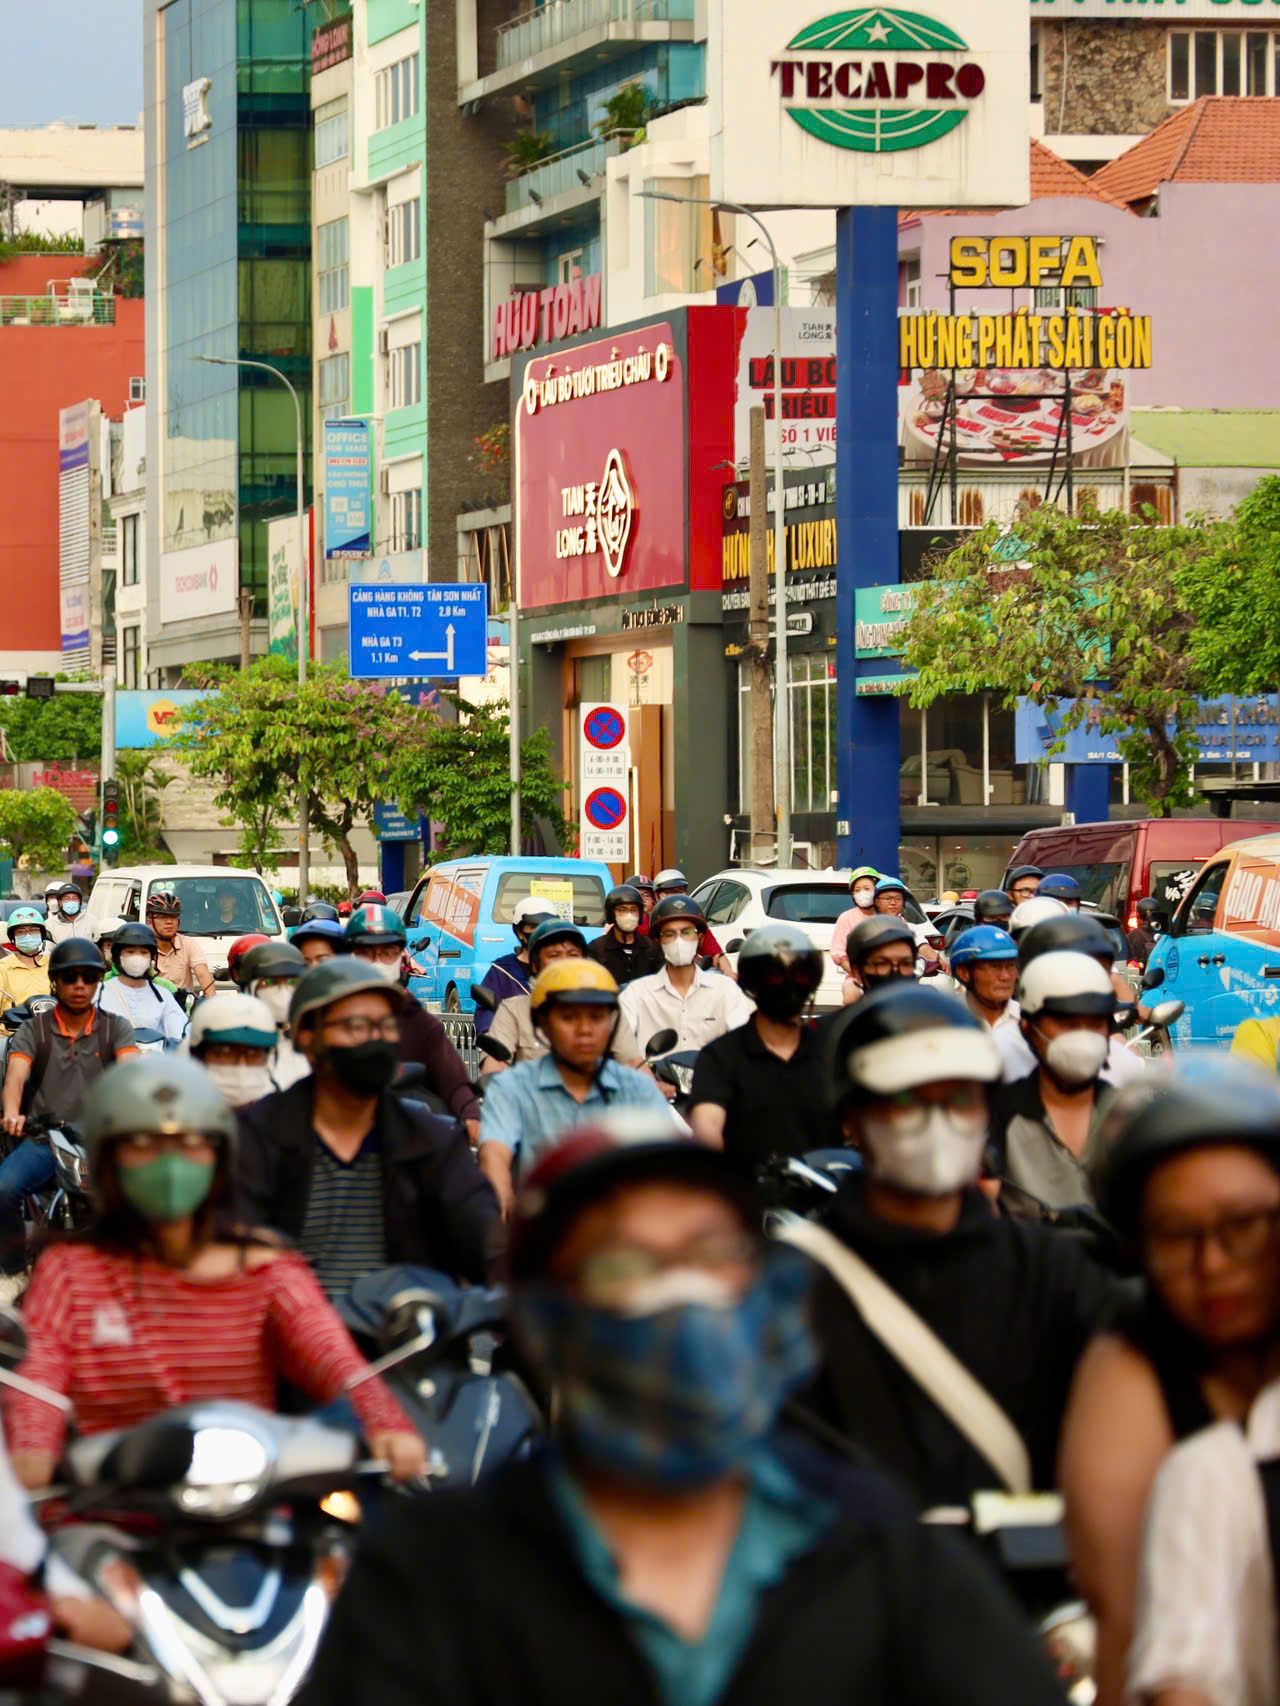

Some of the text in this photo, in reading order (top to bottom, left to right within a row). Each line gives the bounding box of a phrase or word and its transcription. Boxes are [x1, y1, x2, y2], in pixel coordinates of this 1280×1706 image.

[770, 60, 986, 100] TECAPRO
[950, 236, 1103, 287] SOFA
[540, 265, 602, 343] TOÀN
[802, 323, 824, 331] TIAN
[899, 306, 1152, 368] HƯNG PHÁT SÀI GÒN
[623, 346, 651, 385] CHÂU
[327, 432, 369, 443] OFFICE
[816, 423, 837, 444] VIỆ
[561, 485, 585, 517] TIAN
[556, 526, 585, 559] LONG
[352, 586, 482, 602] CẢNG HÀNG KHÔNG TÂN SƠN NHẤT
[367, 603, 385, 617] NHÀ
[386, 606, 397, 617] GA
[412, 606, 422, 617] T2
[438, 606, 466, 617] 2.8 Km
[361, 633, 403, 648] NHÀ GA T3
[371, 652, 399, 663] 1.1 Km
